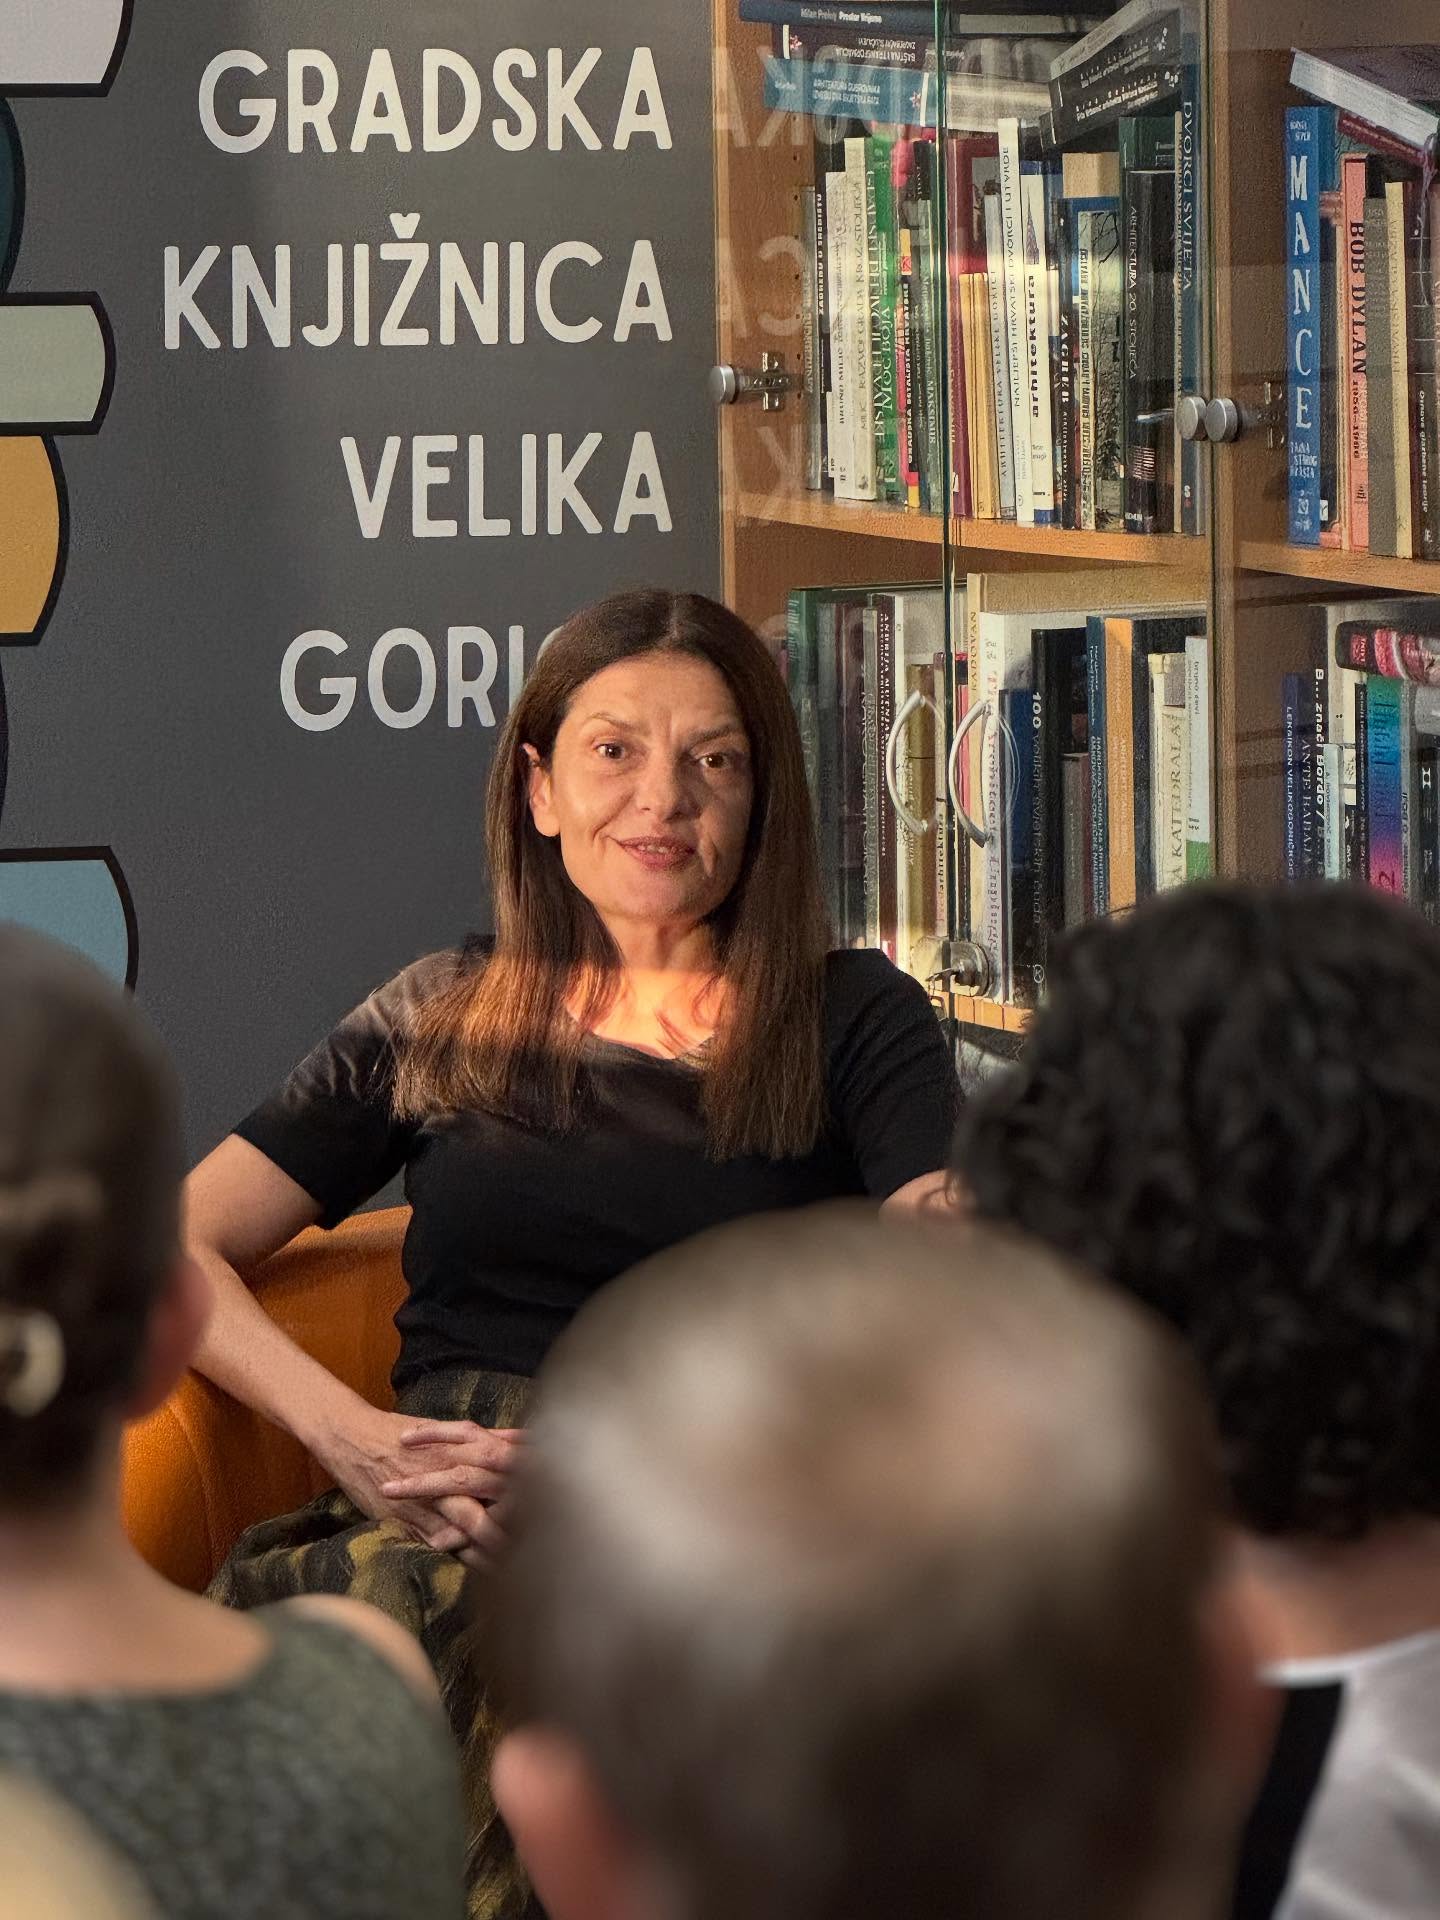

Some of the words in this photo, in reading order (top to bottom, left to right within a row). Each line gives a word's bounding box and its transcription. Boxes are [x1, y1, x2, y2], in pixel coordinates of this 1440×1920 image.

[199, 46, 674, 154] GRADSKA
[1182, 100, 1193, 194] DVORCI
[163, 212, 674, 349] KNJIŽNICA
[1128, 206, 1139, 289] ARHITEKTURA
[1181, 200, 1193, 291] SVIJETA
[1349, 220, 1366, 274] BOB
[1288, 154, 1318, 429] MANCE
[1351, 284, 1368, 376] DYLAN
[1027, 275, 1040, 418] arhitektura
[1128, 318, 1140, 380] STOLJEĆA
[1418, 390, 1426, 429] Osnove
[340, 431, 674, 539] VELIKA
[1419, 431, 1428, 477] glazbene
[280, 625, 563, 732] GORI
[968, 610, 979, 691] RADOVAN
[1032, 691, 1042, 729] 100
[1286, 706, 1294, 766] LEKSIKON
[1315, 702, 1325, 748] znači
[1169, 723, 1183, 858] KATEDRALA
[1302, 739, 1312, 791] ANTE
[1315, 754, 1326, 806] Bordo
